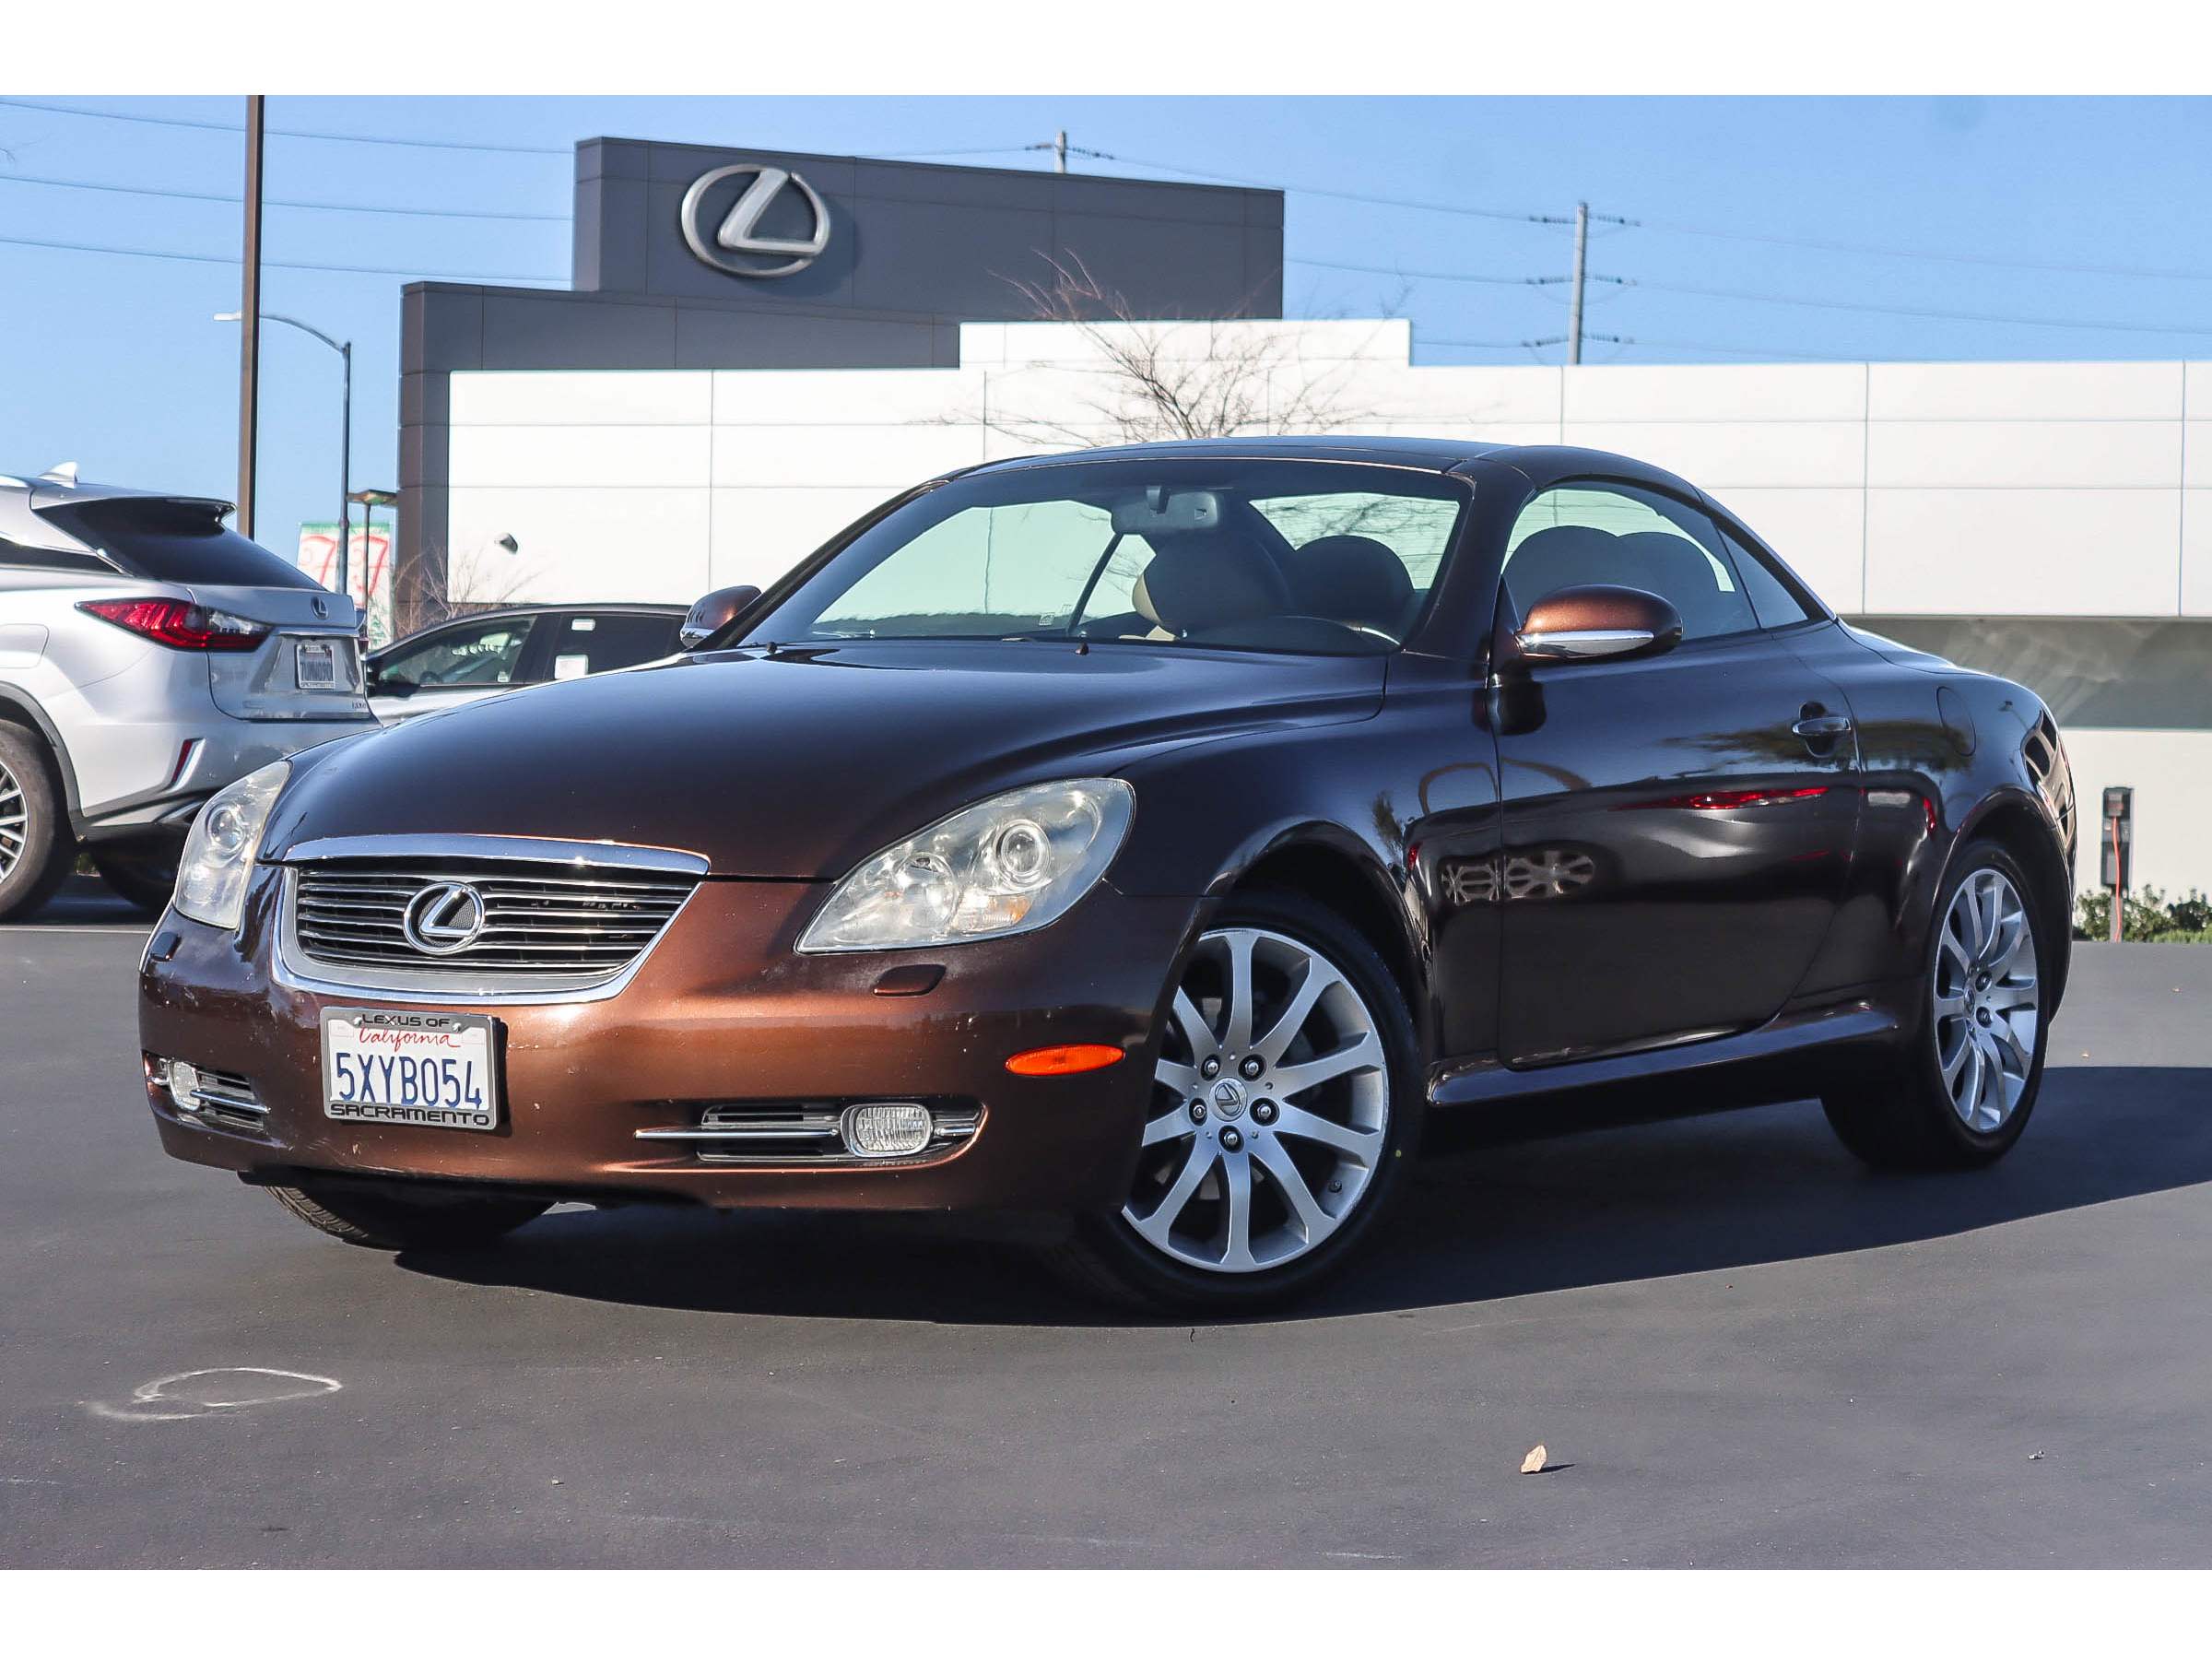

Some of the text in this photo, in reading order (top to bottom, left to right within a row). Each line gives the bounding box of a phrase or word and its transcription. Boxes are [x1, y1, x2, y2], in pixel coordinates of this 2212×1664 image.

[361, 1013, 451, 1027] LEXUS OF
[359, 1027, 461, 1052] California
[335, 1052, 482, 1111] 5XYB054
[330, 1103, 490, 1127] SACRAMENTO
